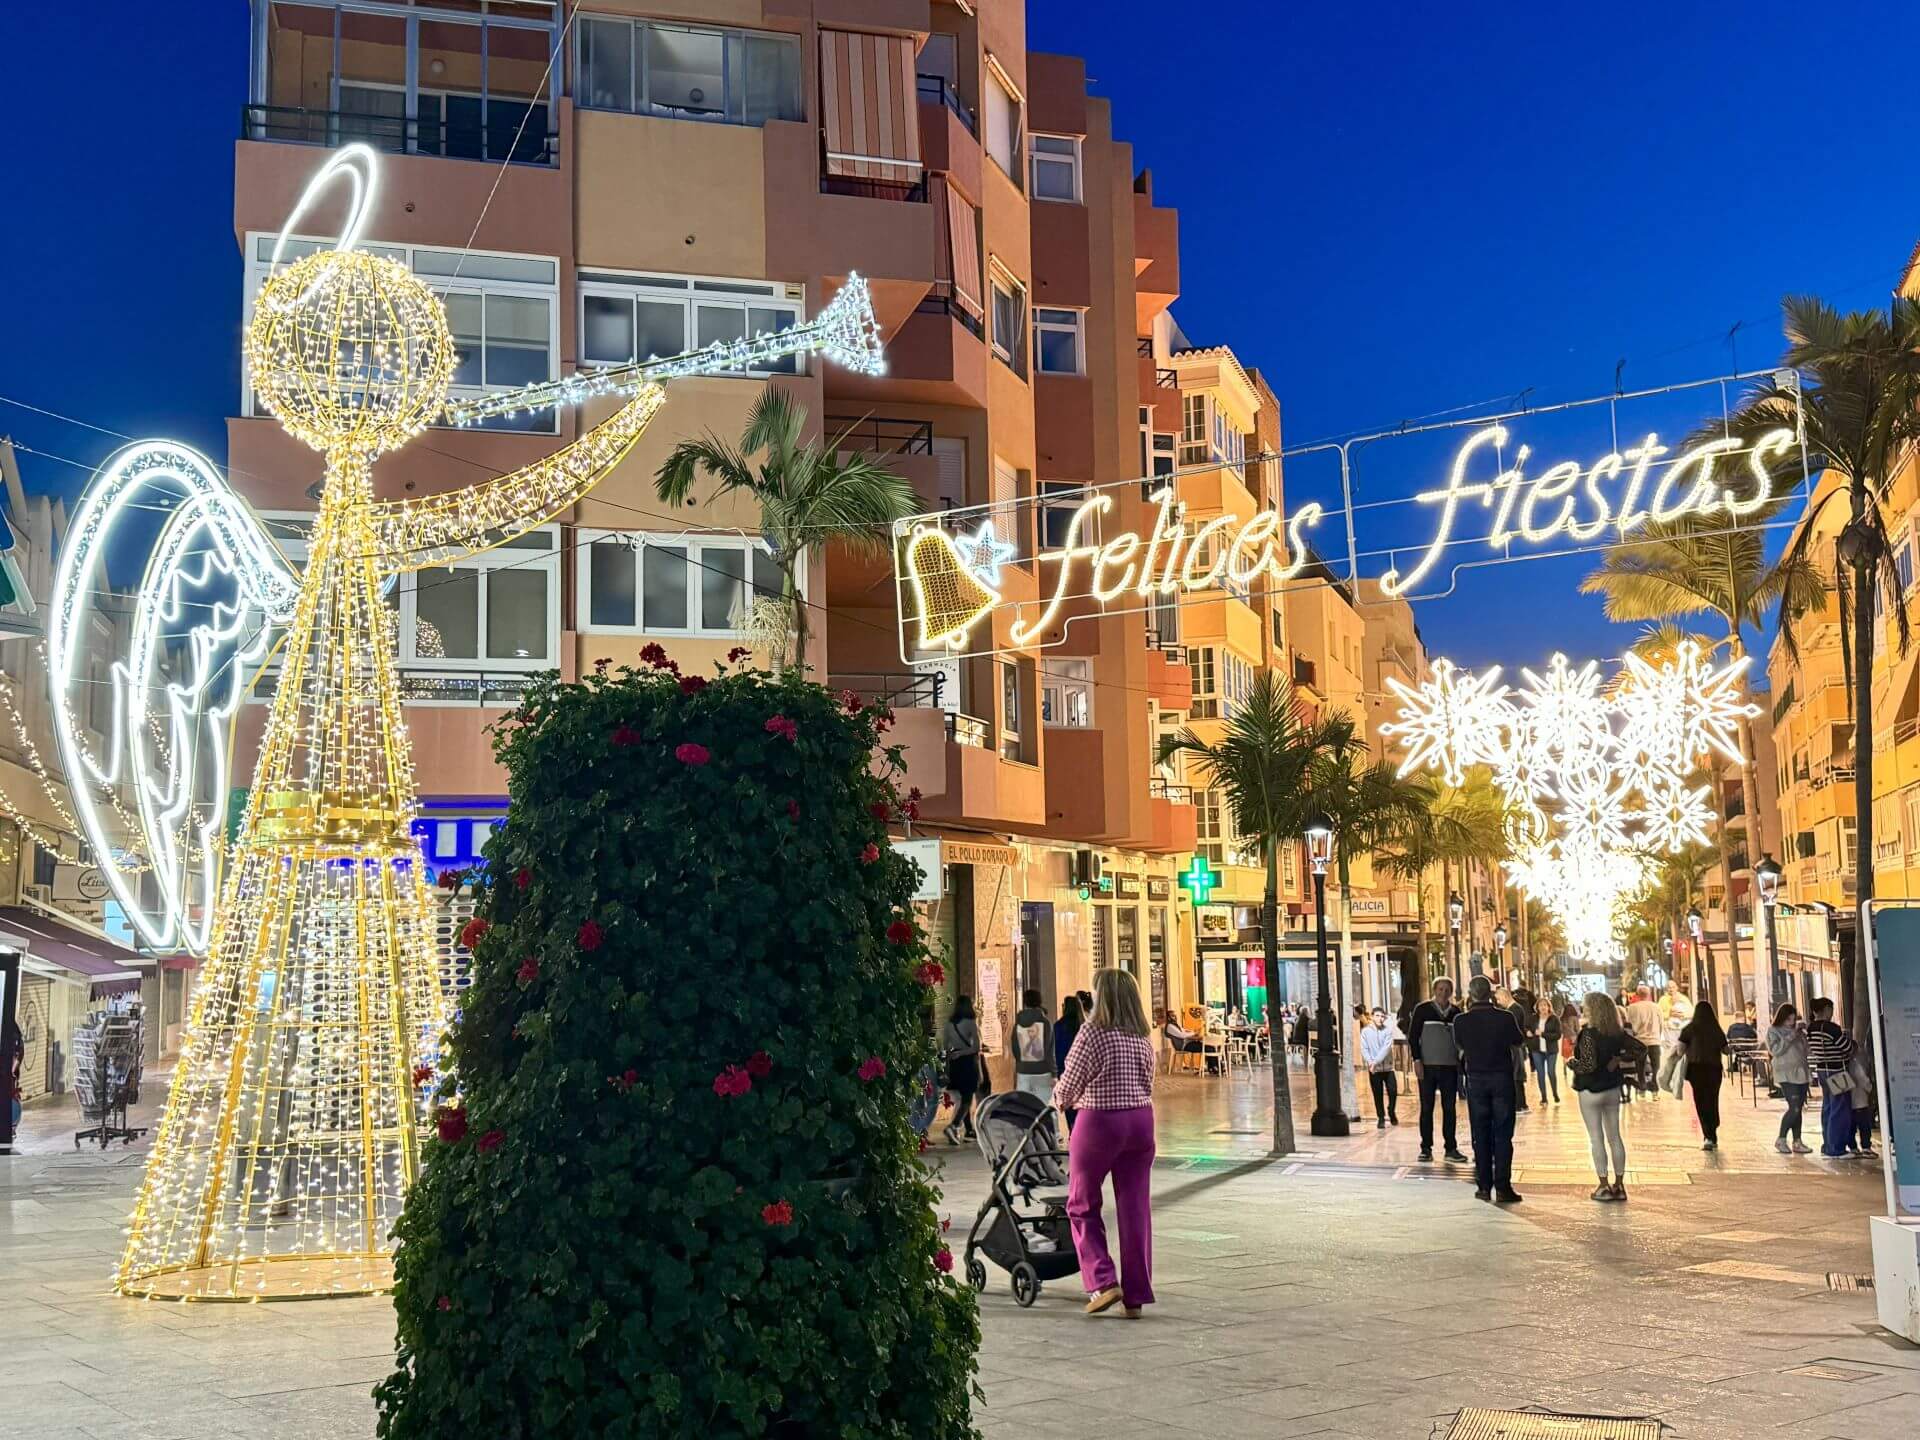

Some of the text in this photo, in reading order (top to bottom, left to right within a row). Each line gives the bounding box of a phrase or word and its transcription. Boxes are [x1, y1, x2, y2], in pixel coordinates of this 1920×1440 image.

[1010, 425, 1796, 645] felices fiestas
[949, 846, 957, 859] EL
[959, 847, 980, 861] POLLO
[982, 849, 1009, 864] DORADO
